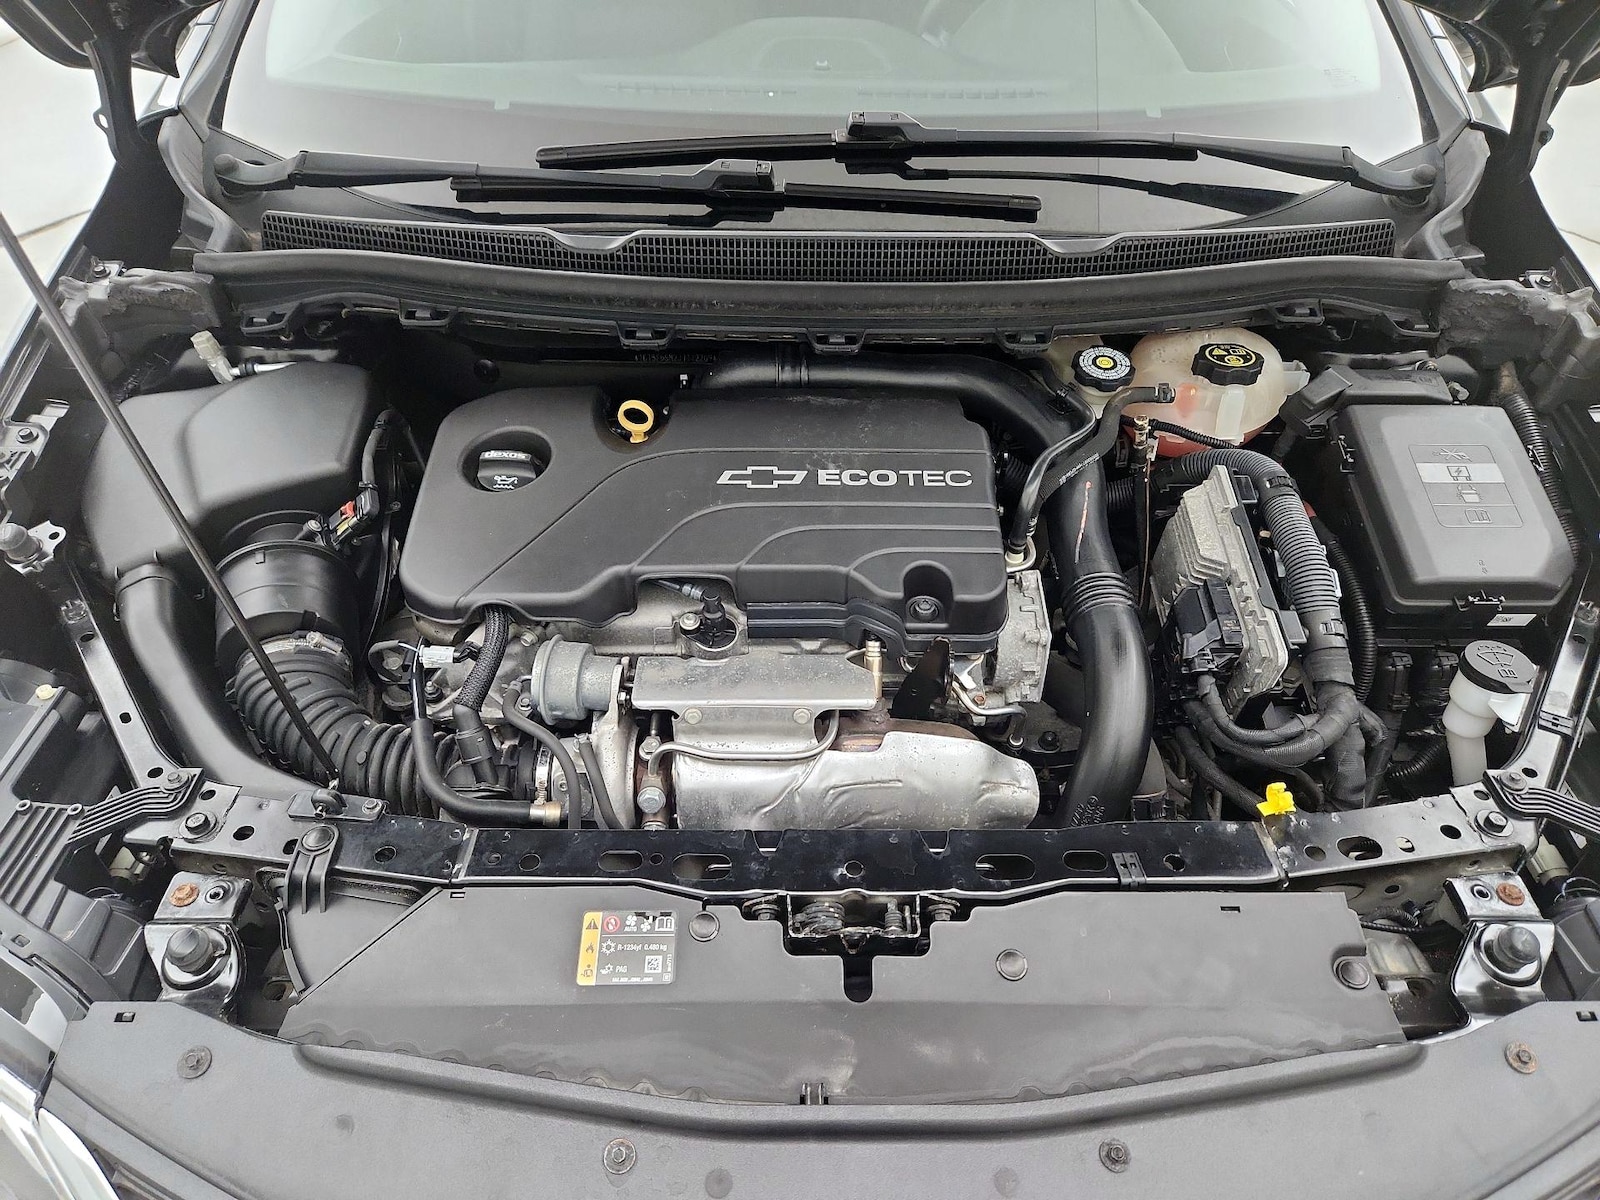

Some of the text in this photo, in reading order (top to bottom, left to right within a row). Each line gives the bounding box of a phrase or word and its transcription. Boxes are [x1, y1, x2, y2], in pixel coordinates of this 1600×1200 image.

[817, 469, 973, 487] ECOTEC
[617, 943, 642, 952] R-1234yf
[660, 943, 667, 952] kg
